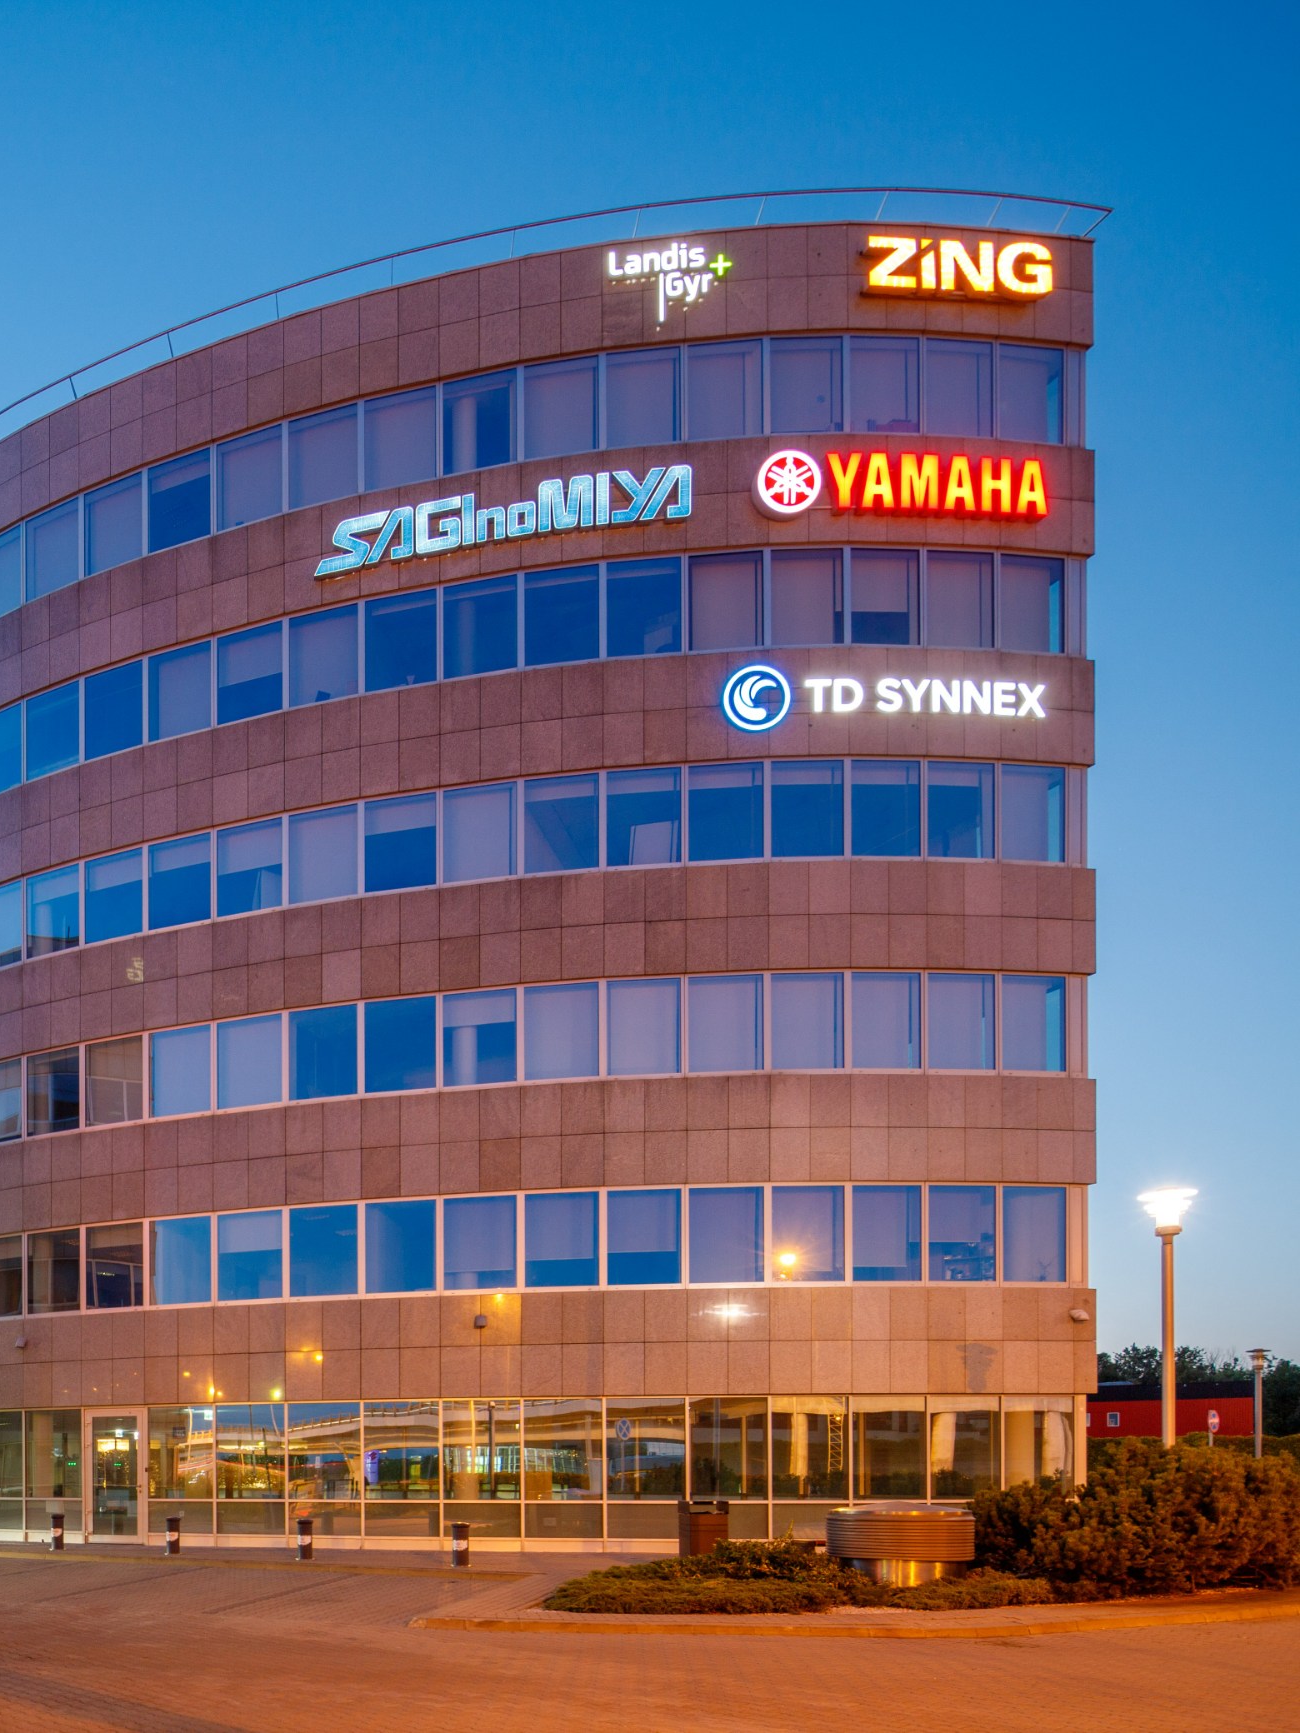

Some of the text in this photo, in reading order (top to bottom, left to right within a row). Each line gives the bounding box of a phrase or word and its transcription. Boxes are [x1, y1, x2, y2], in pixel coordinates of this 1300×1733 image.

[826, 452, 1049, 515] YAMAHA
[804, 677, 1047, 719] TD SYNNEX
